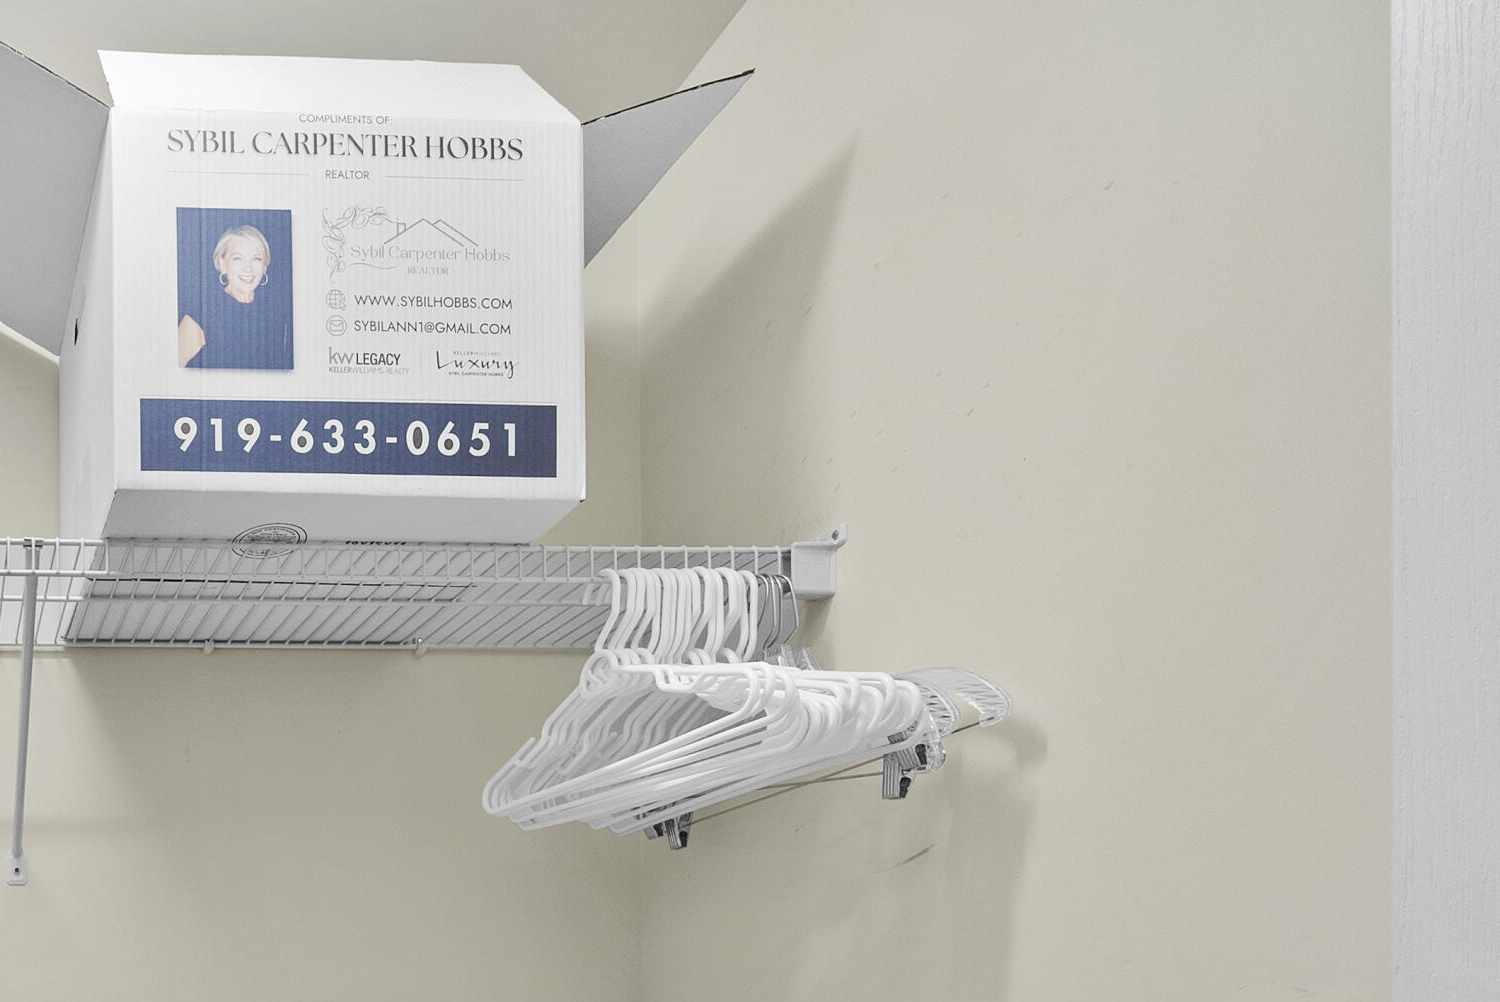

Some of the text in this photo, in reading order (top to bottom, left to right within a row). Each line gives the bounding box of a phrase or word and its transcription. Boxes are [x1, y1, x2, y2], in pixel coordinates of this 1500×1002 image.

[299, 113, 394, 126] COMPLIMENTS OF:
[167, 129, 524, 161] SYBIL CARPENTER HOBBS
[325, 169, 370, 181] REALTOR
[350, 244, 511, 263] Sybil Carpenter Hobbs
[407, 265, 450, 277] REALTOR
[354, 294, 513, 310] WWW.SYBILHOBBS.COM
[354, 319, 512, 336] SYBILANN1@GMAIL.COM
[356, 352, 401, 366] LEGACY
[436, 350, 520, 379] Luxury
[173, 416, 517, 457] 919-633-0651
